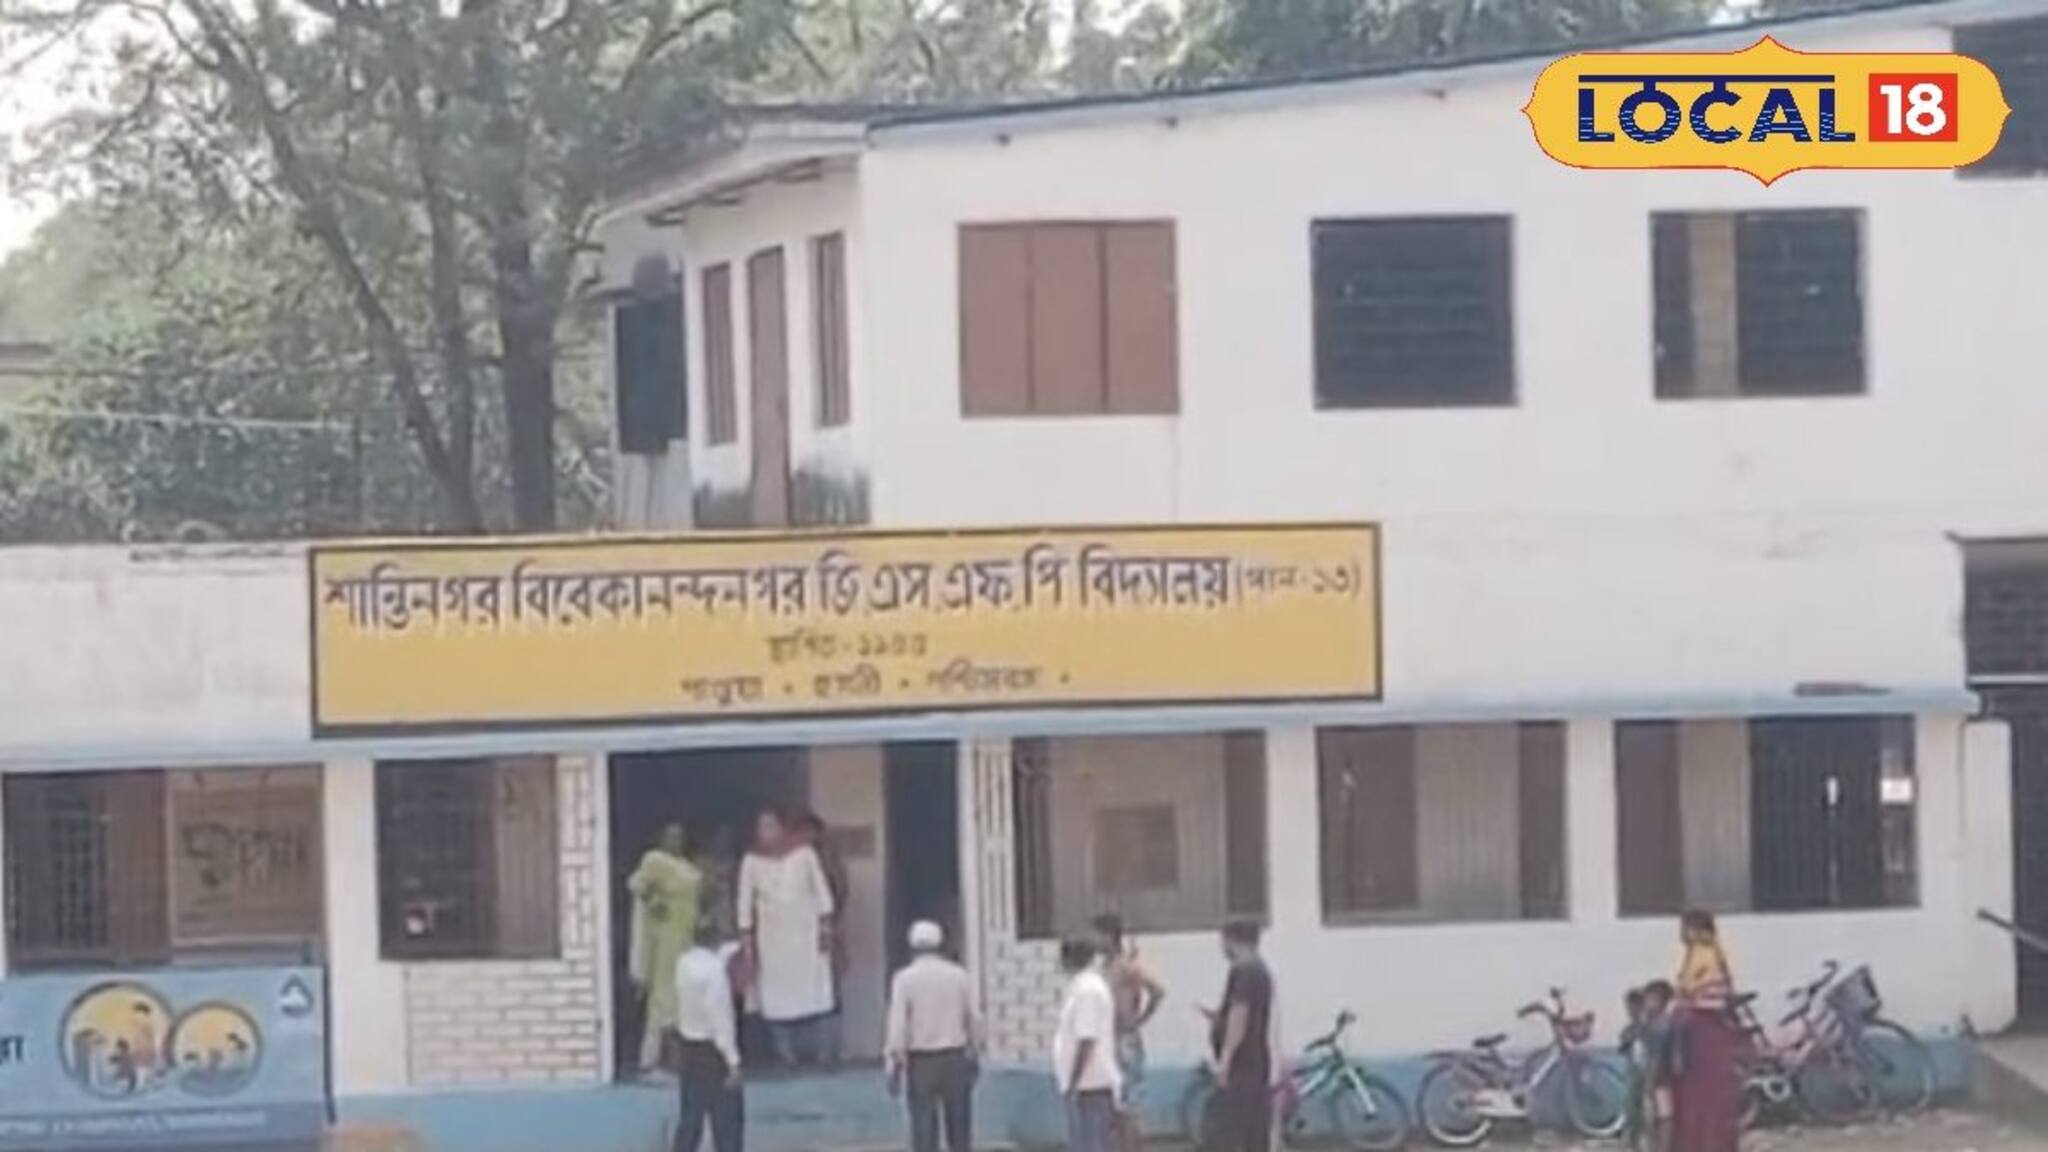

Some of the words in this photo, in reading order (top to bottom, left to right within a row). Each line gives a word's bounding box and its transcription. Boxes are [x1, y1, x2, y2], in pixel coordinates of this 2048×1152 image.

[323, 561, 503, 630] শান্তিনগর
[511, 557, 809, 625] বিবেকানন্দনগর
[1078, 542, 1231, 609] বিদ্যালয়
